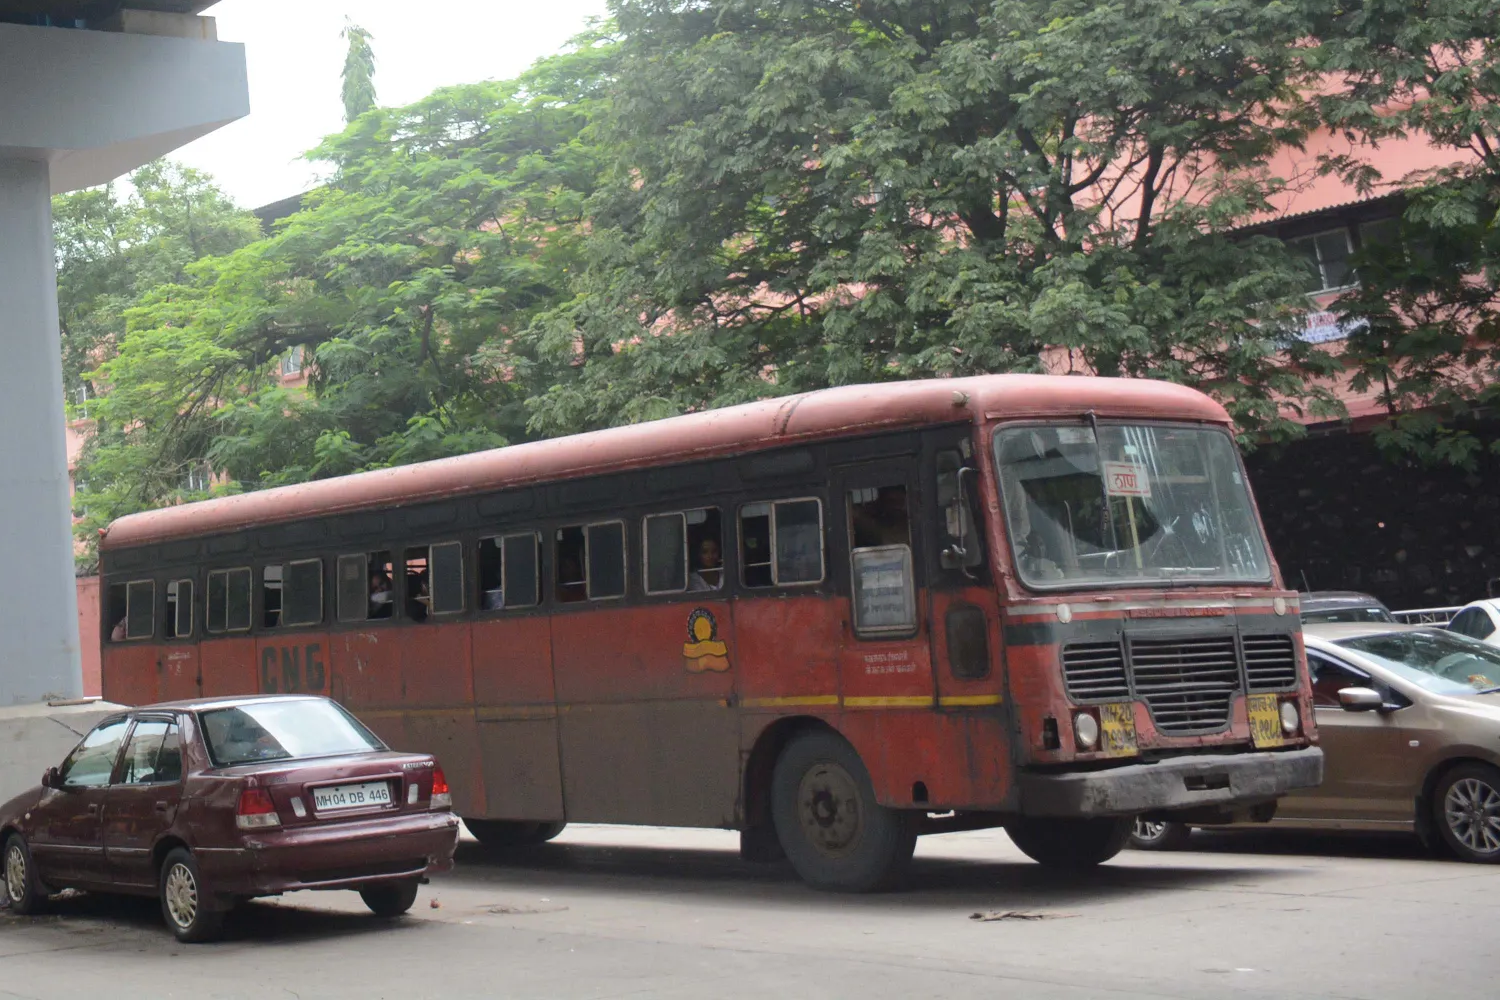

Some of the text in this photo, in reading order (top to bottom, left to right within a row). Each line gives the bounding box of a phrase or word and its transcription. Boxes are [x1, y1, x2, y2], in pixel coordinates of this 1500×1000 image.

[261, 643, 326, 694] CNG
[315, 788, 388, 807] MH 04 DB 446
